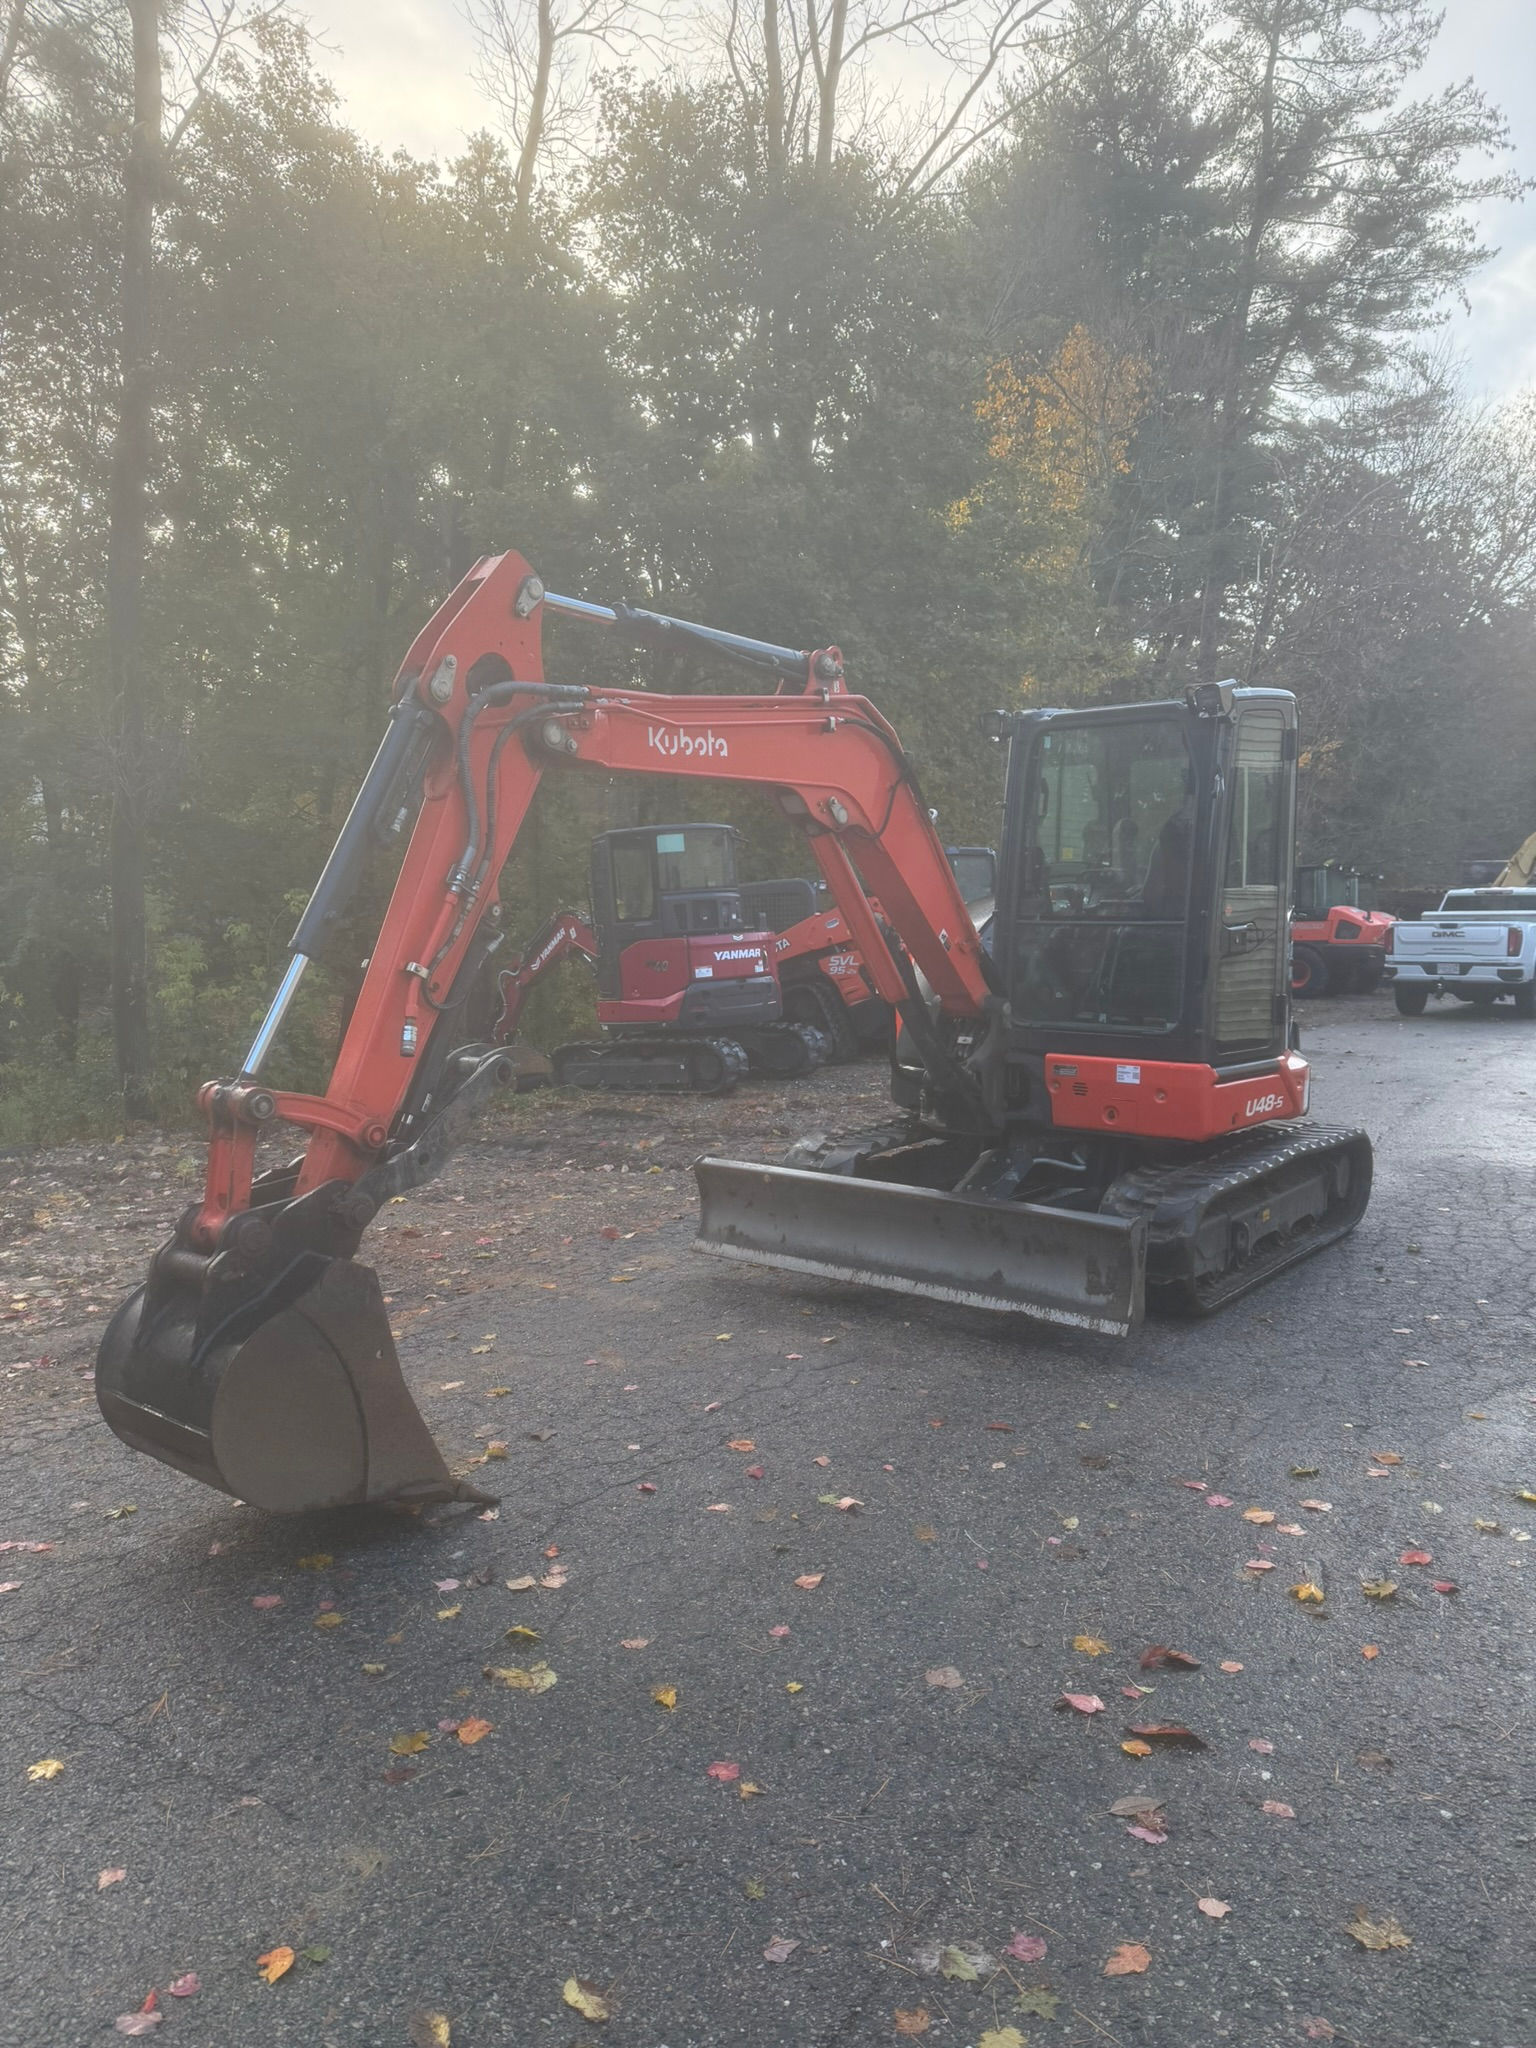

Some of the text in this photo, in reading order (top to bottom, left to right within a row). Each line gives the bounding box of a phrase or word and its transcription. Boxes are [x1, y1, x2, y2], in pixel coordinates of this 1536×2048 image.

[648, 726, 728, 757] Kubota
[775, 938, 790, 953] TA
[713, 948, 761, 961] YANMAR
[828, 955, 860, 967] SVL
